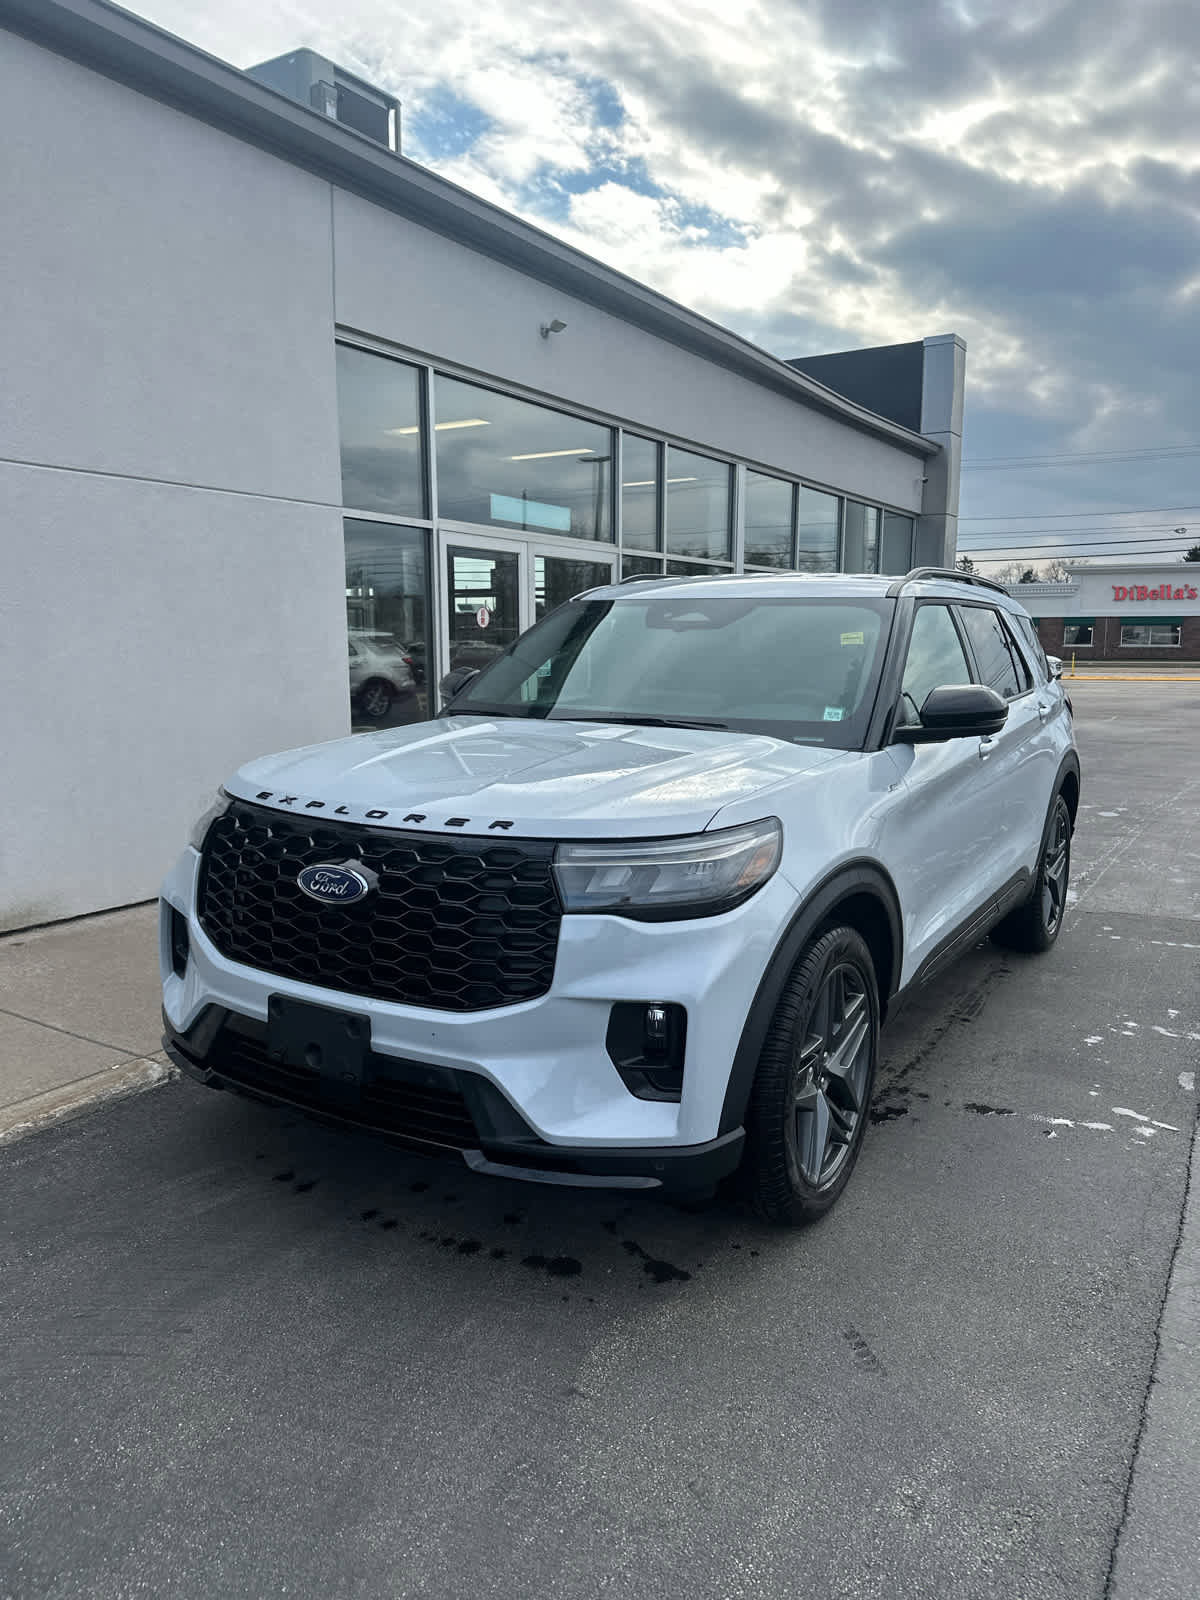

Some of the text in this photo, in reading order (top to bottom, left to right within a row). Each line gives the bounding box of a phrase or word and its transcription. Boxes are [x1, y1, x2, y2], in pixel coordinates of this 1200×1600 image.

[1112, 584, 1198, 601] DiBella's
[256, 791, 515, 830] EXPLORER
[310, 871, 348, 895] Ford
